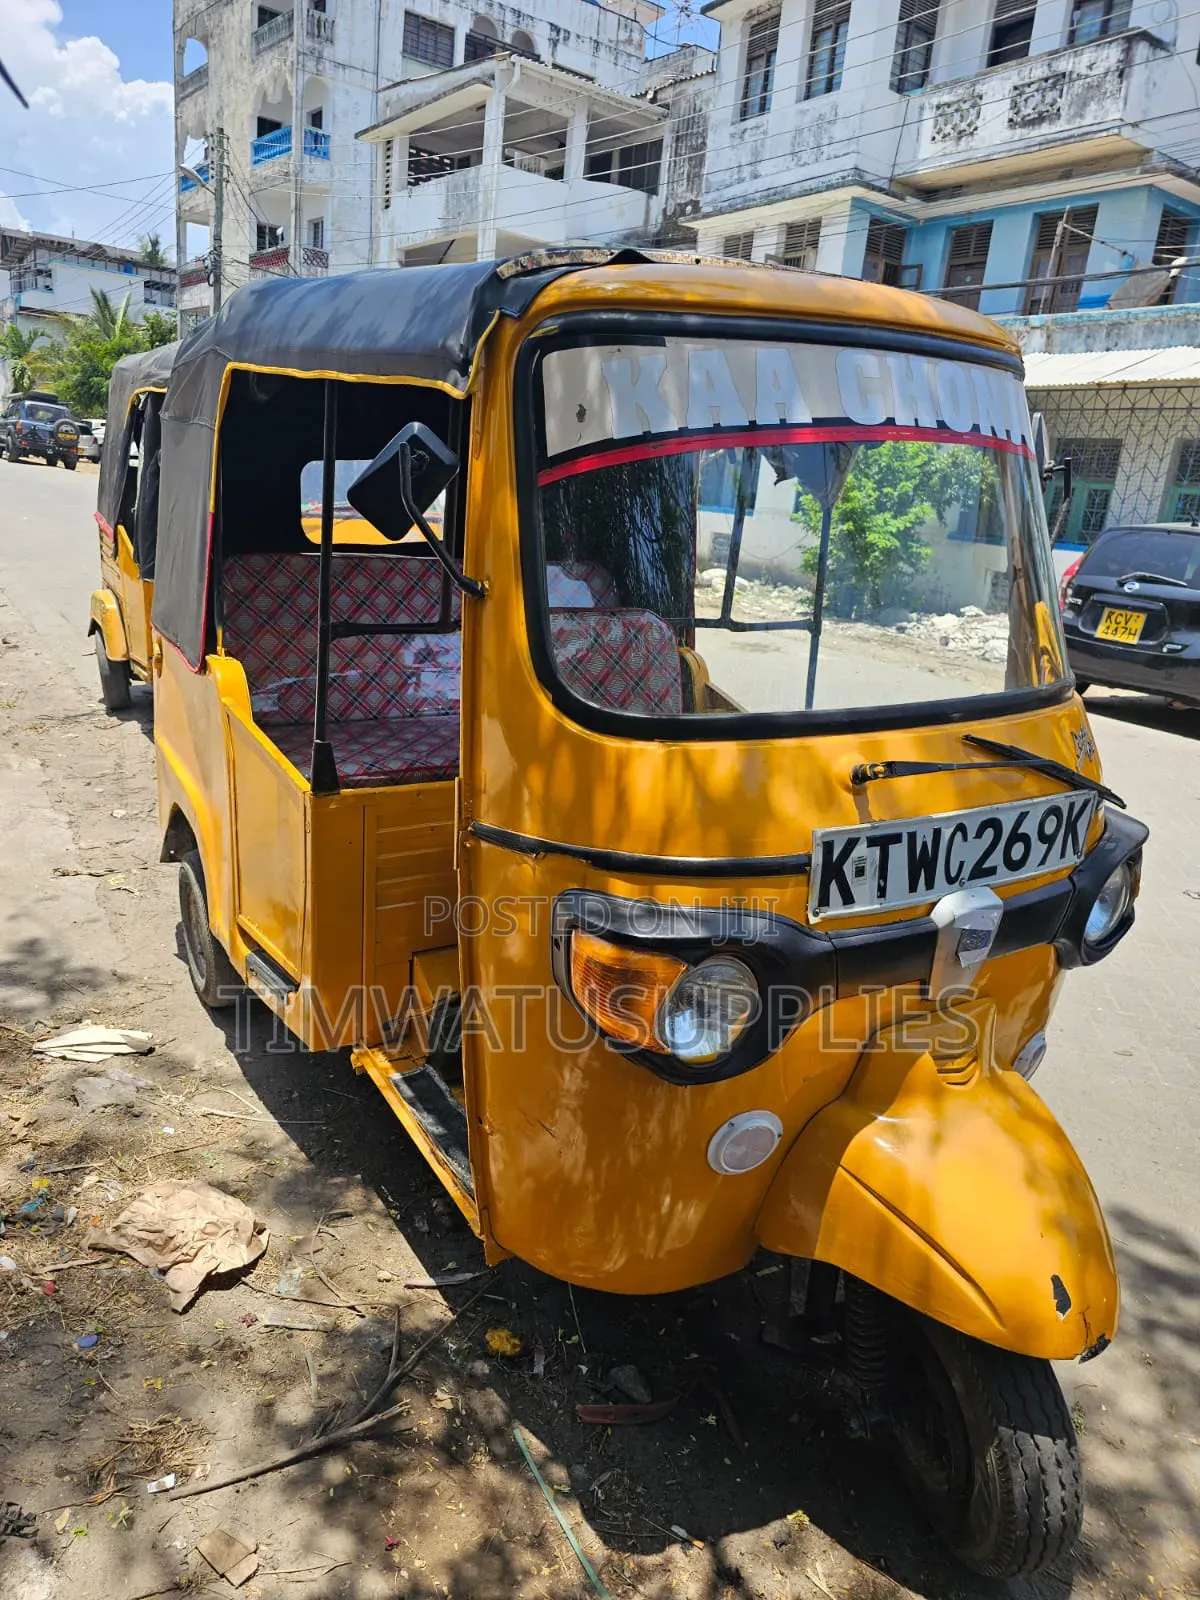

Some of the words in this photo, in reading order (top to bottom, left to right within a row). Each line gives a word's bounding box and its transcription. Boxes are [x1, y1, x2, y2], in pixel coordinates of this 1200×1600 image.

[601, 347, 813, 440] KAA
[1105, 610, 1133, 626] KCV
[817, 797, 1092, 908] KTWC269K
